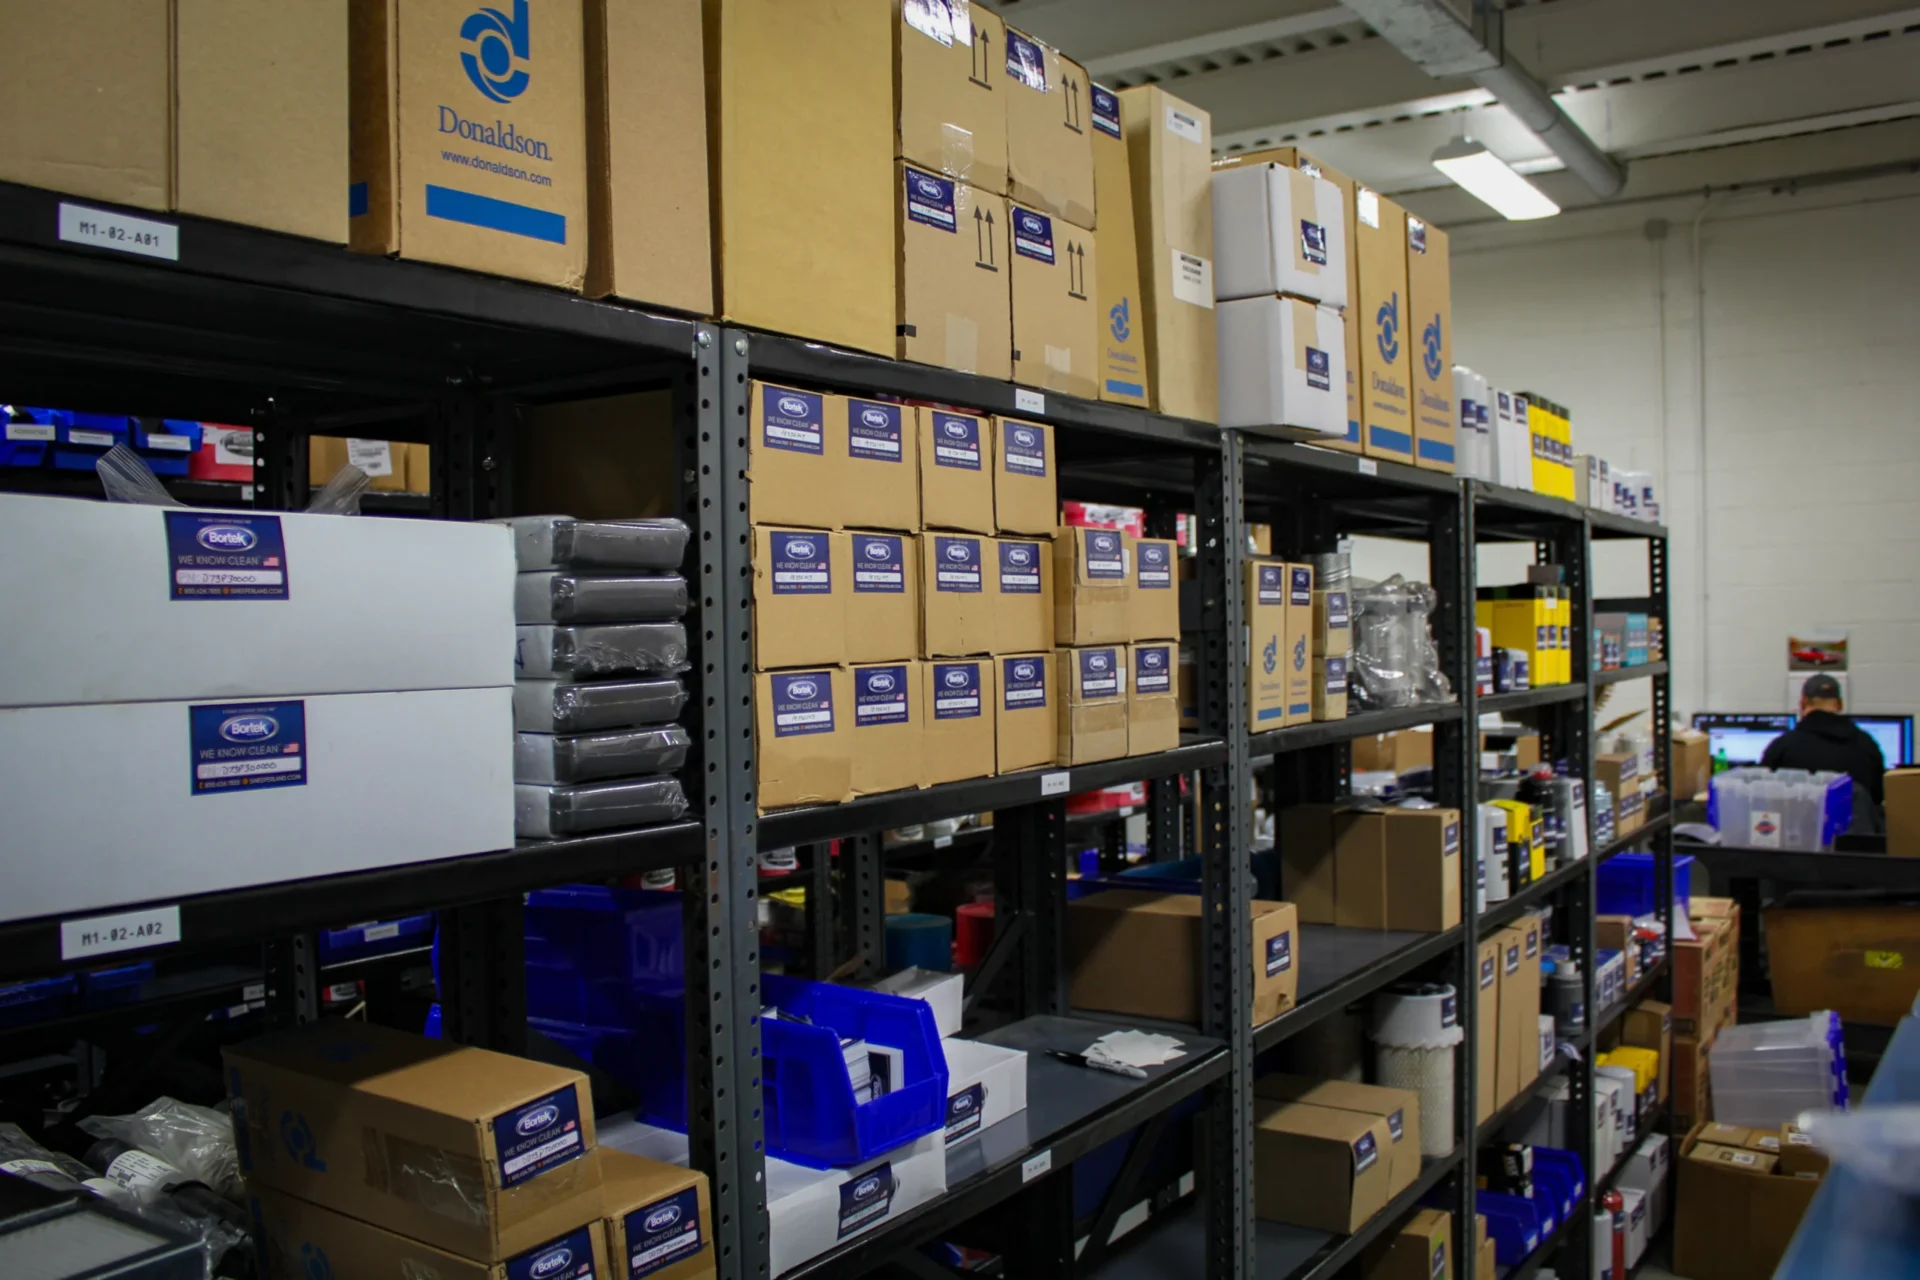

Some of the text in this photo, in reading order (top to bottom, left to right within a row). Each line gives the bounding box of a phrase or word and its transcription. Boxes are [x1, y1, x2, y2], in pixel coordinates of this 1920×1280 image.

[441, 150, 552, 187] www.donaldson.com
[79, 221, 159, 247] M1-02-A01
[208, 531, 248, 547] Bortek
[178, 555, 259, 566] WE KNOW CLEAN
[231, 721, 269, 735] Bortek
[199, 745, 279, 759] WE KNOW CLEAN
[81, 922, 163, 947] M1-02-A02
[523, 1111, 552, 1130] Bortek
[503, 1147, 517, 1157] WE
[516, 1138, 538, 1152] KNOW
[538, 1127, 561, 1143] CLEAN
[650, 1210, 675, 1228] Bortek
[632, 1244, 642, 1253] WE
[643, 1235, 662, 1248] KNOW
[662, 1226, 682, 1240] CLEAN
[537, 1253, 565, 1274] Bortek
